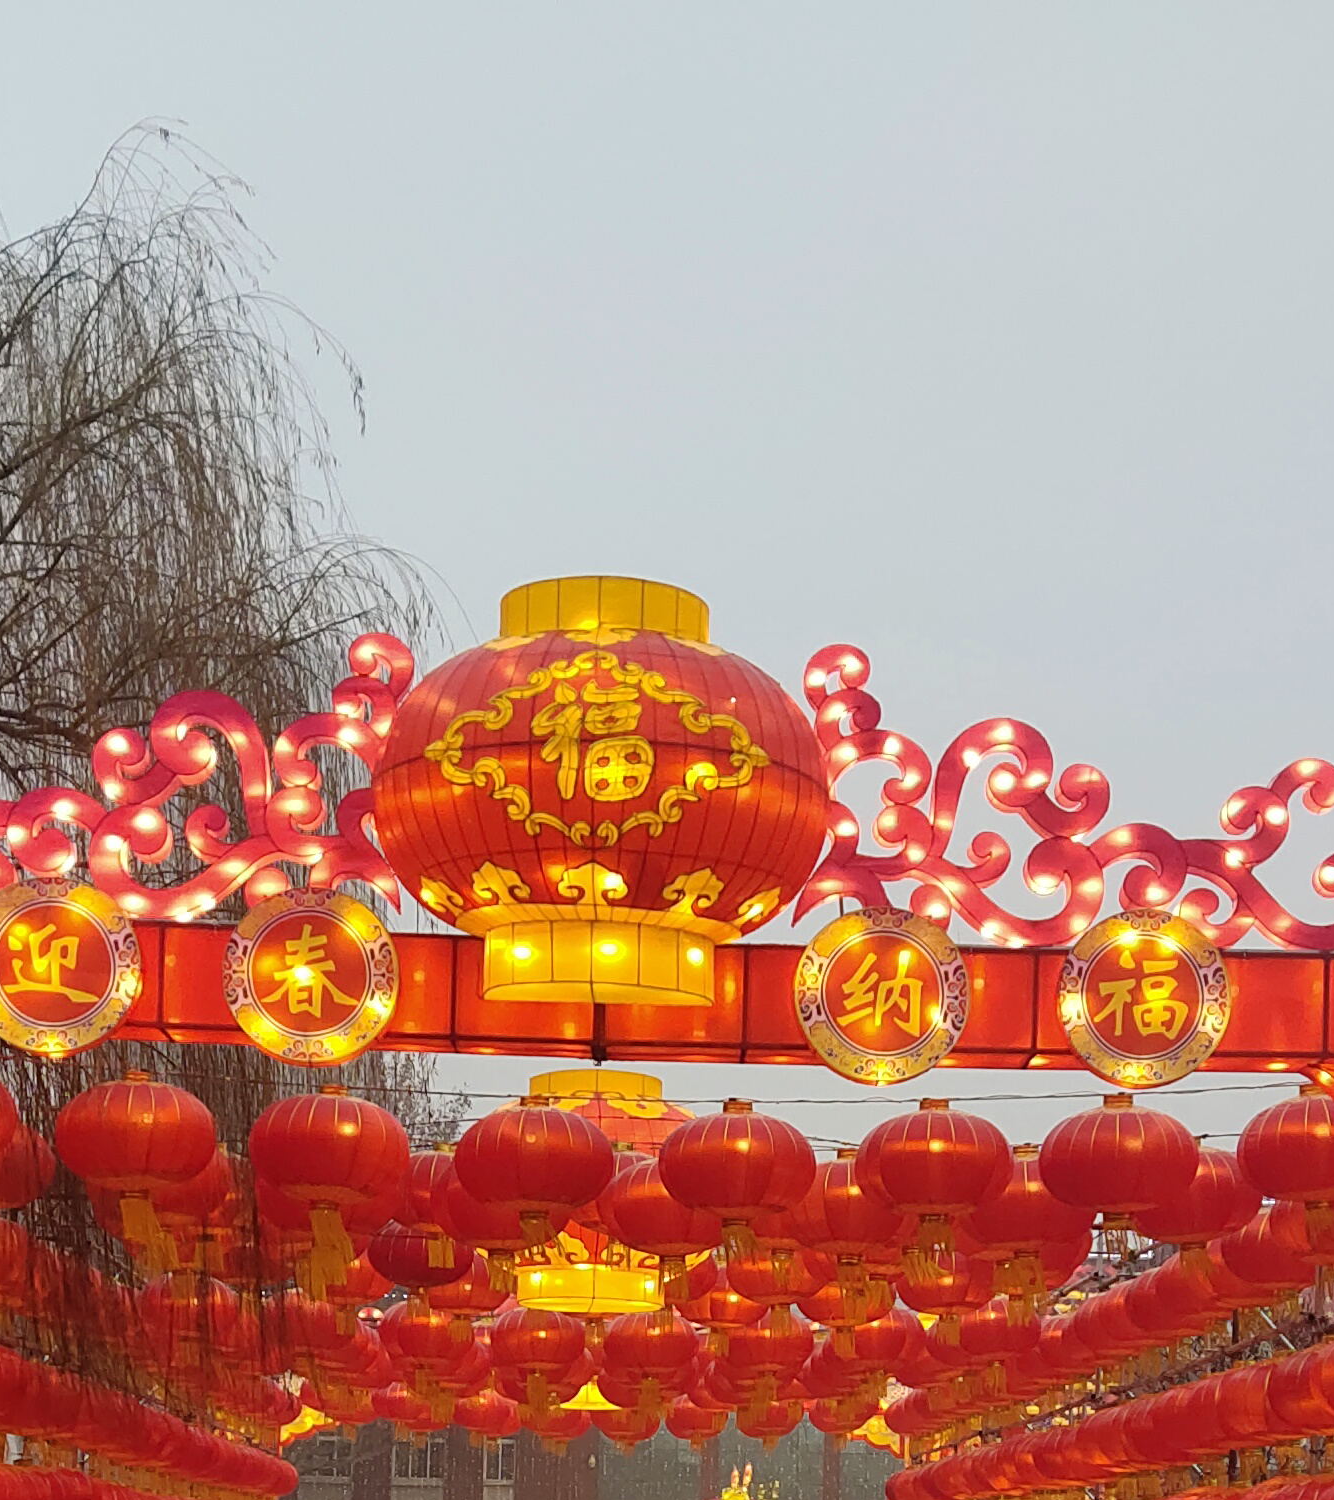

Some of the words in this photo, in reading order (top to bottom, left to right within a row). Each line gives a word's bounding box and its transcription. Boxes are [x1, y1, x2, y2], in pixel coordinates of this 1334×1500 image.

[531, 680, 655, 802] 福
[4, 923, 100, 1003] 迎
[262, 923, 359, 1018] 春
[836, 949, 924, 1038] 纳
[1093, 949, 1189, 1040] 福
